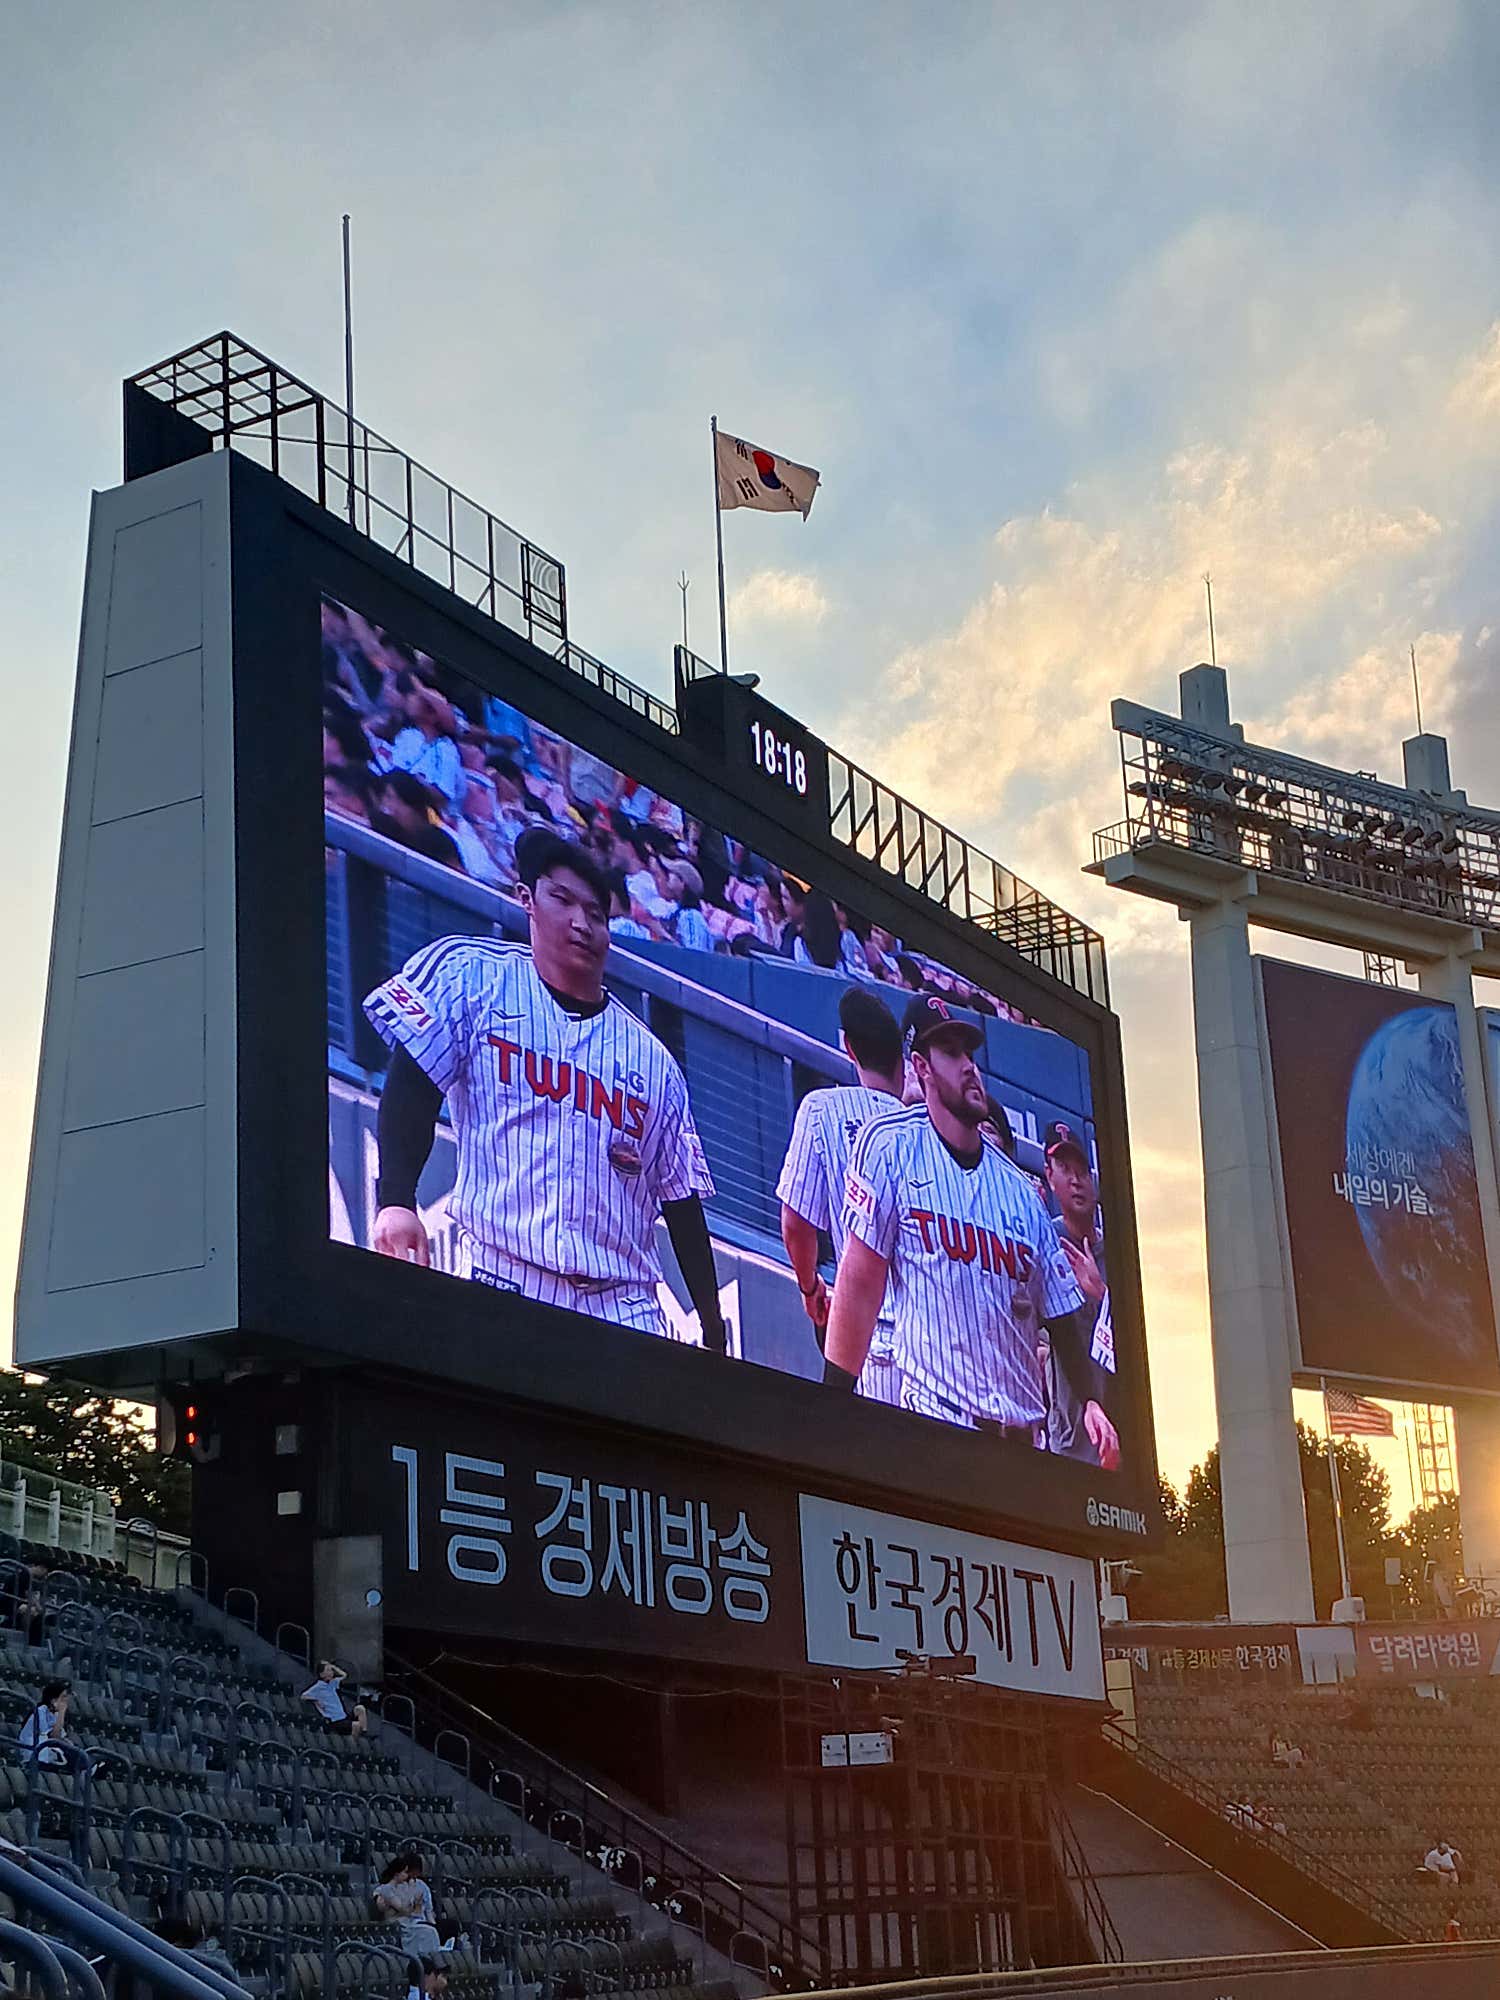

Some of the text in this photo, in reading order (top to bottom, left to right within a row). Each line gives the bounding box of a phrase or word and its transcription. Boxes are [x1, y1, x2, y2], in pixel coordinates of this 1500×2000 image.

[751, 721, 807, 794] 18:18
[928, 997, 950, 1020] T
[487, 1033, 650, 1141] TWINS
[614, 1061, 646, 1094] LG
[1346, 1141, 1416, 1180] 세상에겐
[1333, 1172, 1389, 1210] 내일의
[1001, 1210, 1026, 1237] LG
[910, 1207, 1035, 1283] TWINS
[392, 1444, 771, 1624] 1등 경제방송
[1099, 1502, 1147, 1536] SAMIK
[833, 1531, 1074, 1672] 한국경제TV
[1235, 1644, 1292, 1671] 한국경제
[1369, 1632, 1480, 1672] 달려라병원
